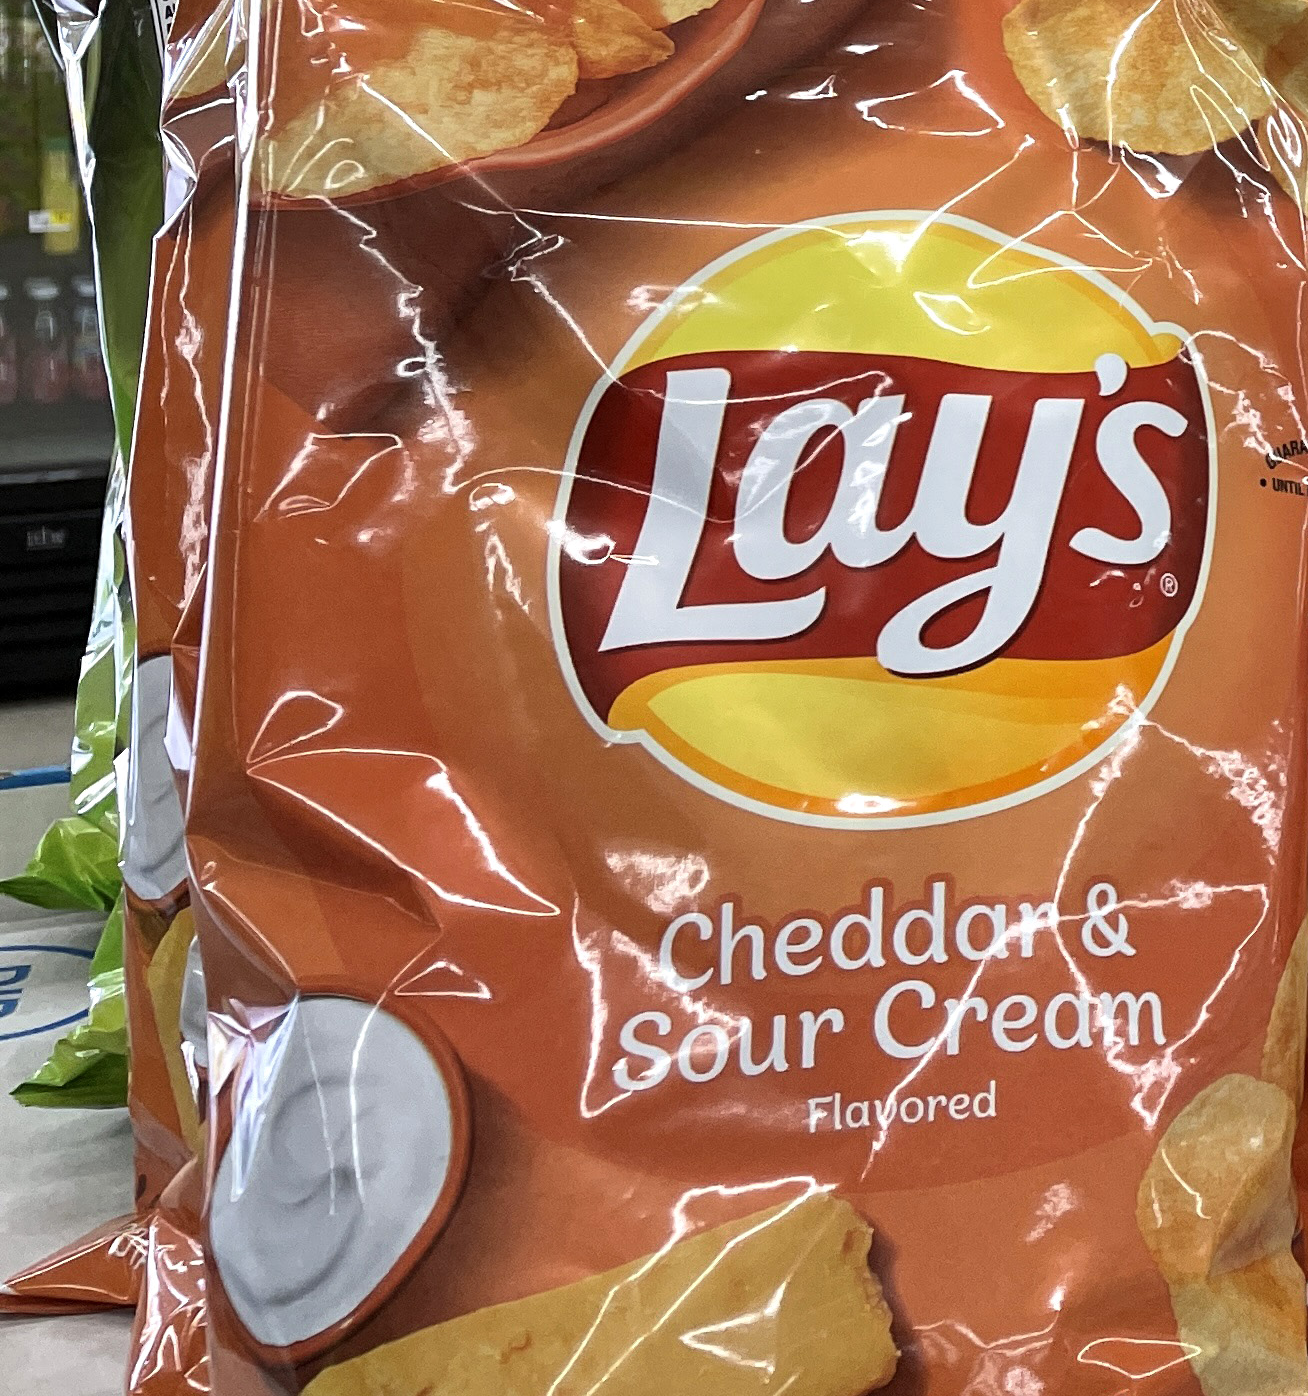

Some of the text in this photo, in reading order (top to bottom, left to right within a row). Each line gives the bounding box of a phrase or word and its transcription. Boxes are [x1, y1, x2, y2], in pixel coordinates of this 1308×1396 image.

[599, 352, 1189, 678] Lay's
[1272, 477, 1305, 496] UNTIL
[660, 881, 1137, 993] Cheddar &
[616, 980, 1167, 1093] Sour Cream
[807, 1080, 998, 1135] Flavored
